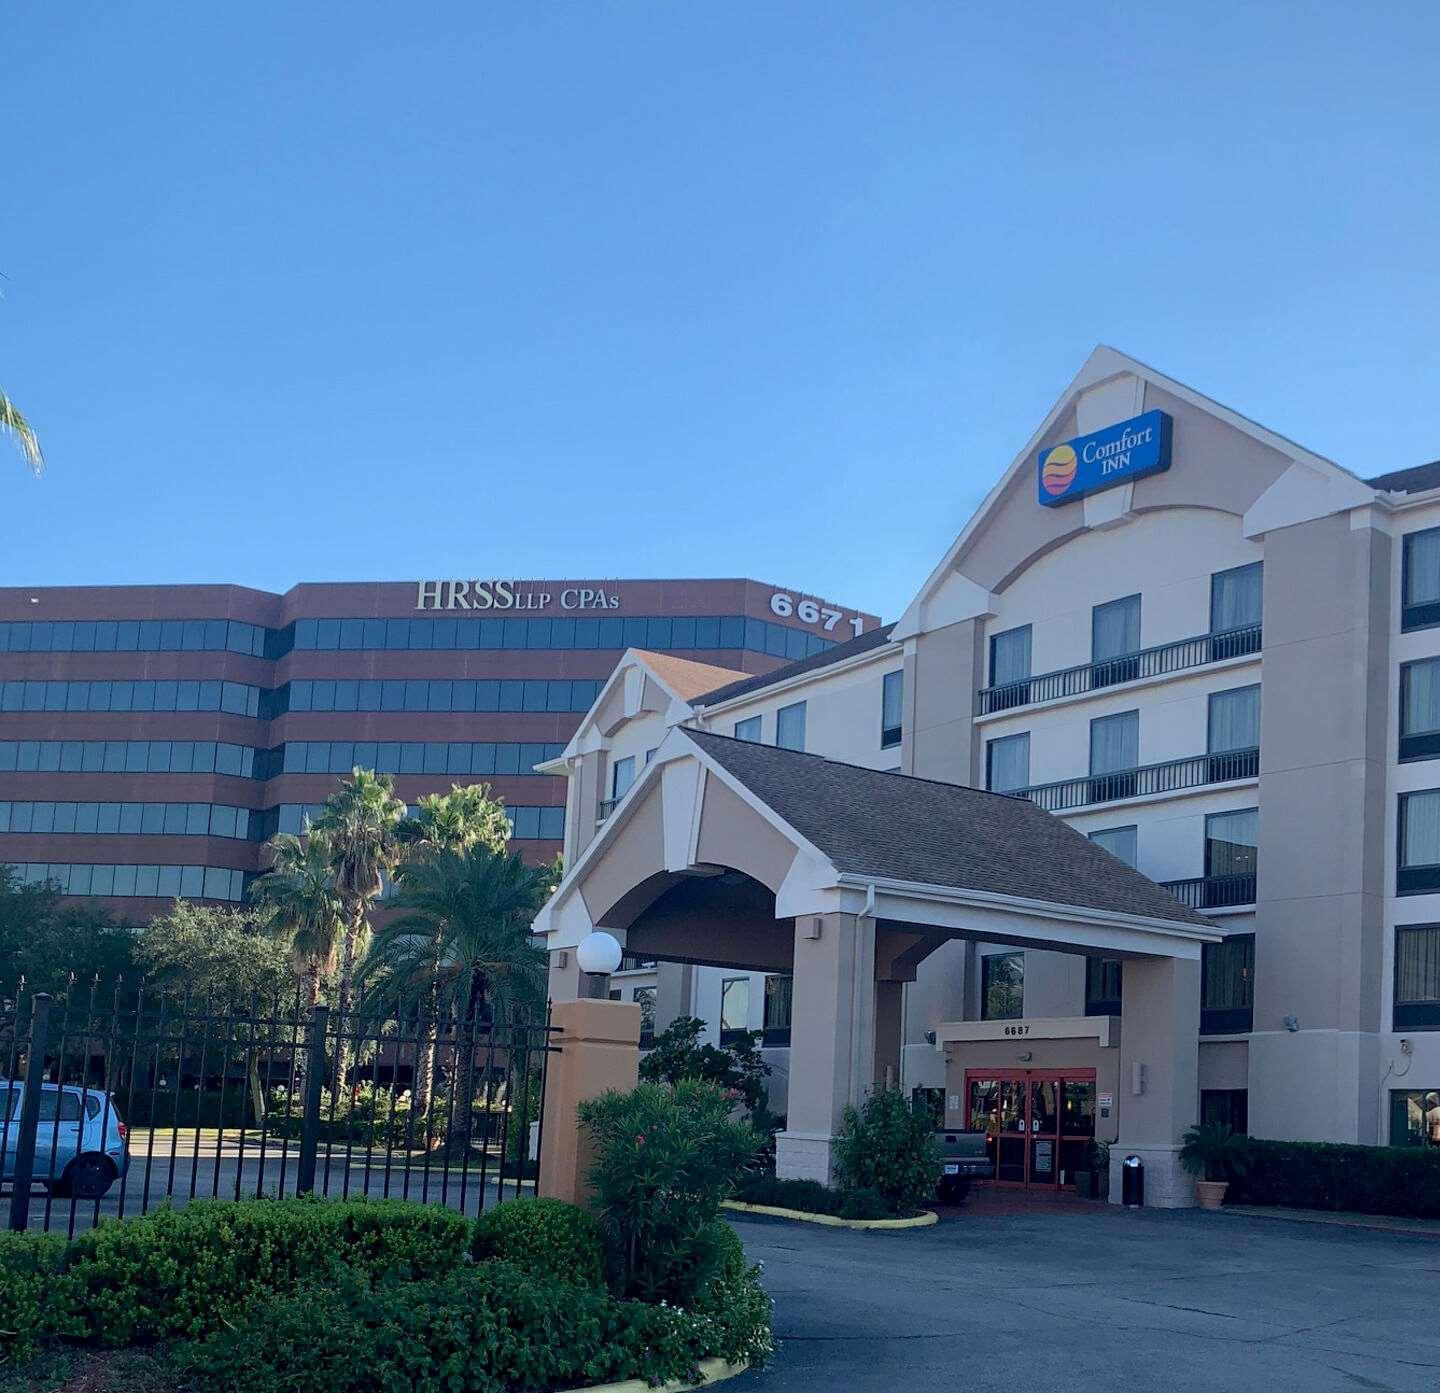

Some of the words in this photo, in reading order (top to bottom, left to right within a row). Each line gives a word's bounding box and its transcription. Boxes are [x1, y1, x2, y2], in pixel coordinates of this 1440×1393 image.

[1082, 427, 1153, 464] Comfort
[1102, 452, 1131, 475] INN
[560, 588, 619, 610] CPAs
[770, 593, 864, 637] 6671
